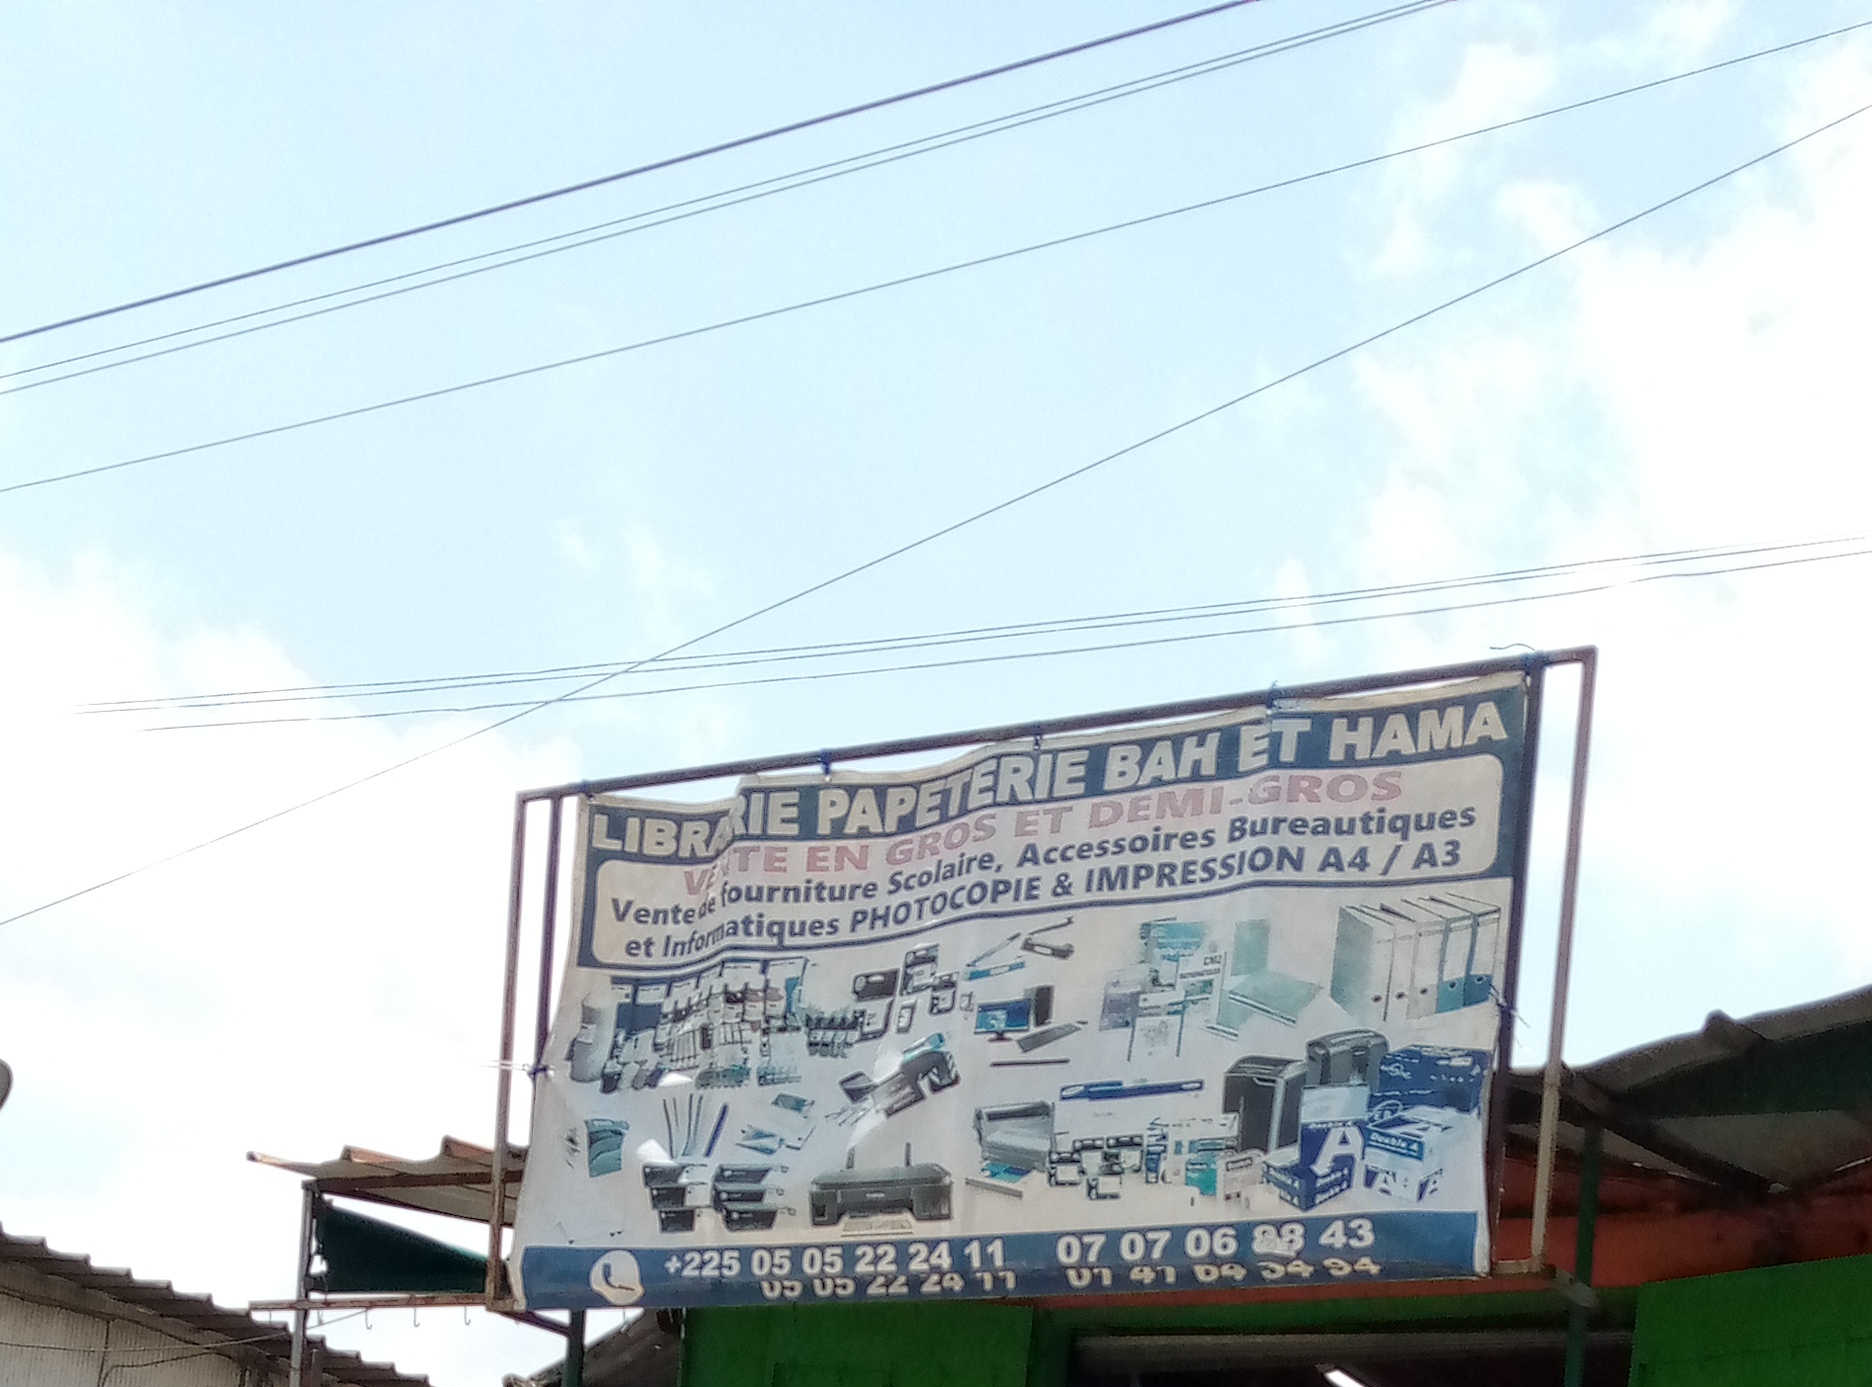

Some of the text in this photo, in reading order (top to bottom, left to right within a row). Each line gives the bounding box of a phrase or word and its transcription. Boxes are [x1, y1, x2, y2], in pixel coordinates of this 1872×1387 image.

[806, 845, 869, 873] EN
[885, 813, 997, 865] GROS
[1014, 806, 1073, 838] ET
[1088, 771, 1402, 829] DEMI-GROS
[817, 750, 1089, 835] PAPETERIE
[1103, 731, 1221, 791] BAH
[1238, 718, 1312, 772] ET
[1328, 701, 1508, 761] HAMA
[611, 897, 695, 925] Vente
[887, 851, 1003, 896] Scolaire,
[1016, 825, 1216, 868] Accessoires
[1227, 806, 1476, 843] Bureautiques
[625, 839, 1462, 958] et Informatiques PHOTOCOPIE & IMPRESSION A4 / A3
[664, 1249, 741, 1277] +225
[751, 1247, 792, 1276] 05
[801, 1245, 844, 1275] 05
[854, 1243, 897, 1274] 22
[907, 1241, 953, 1272] 24
[963, 1238, 1005, 1269] 11
[1056, 1233, 1107, 1265] 07
[1119, 1230, 1172, 1261] 07
[1184, 1226, 1238, 1258] 06
[1318, 1217, 1376, 1248] 43
